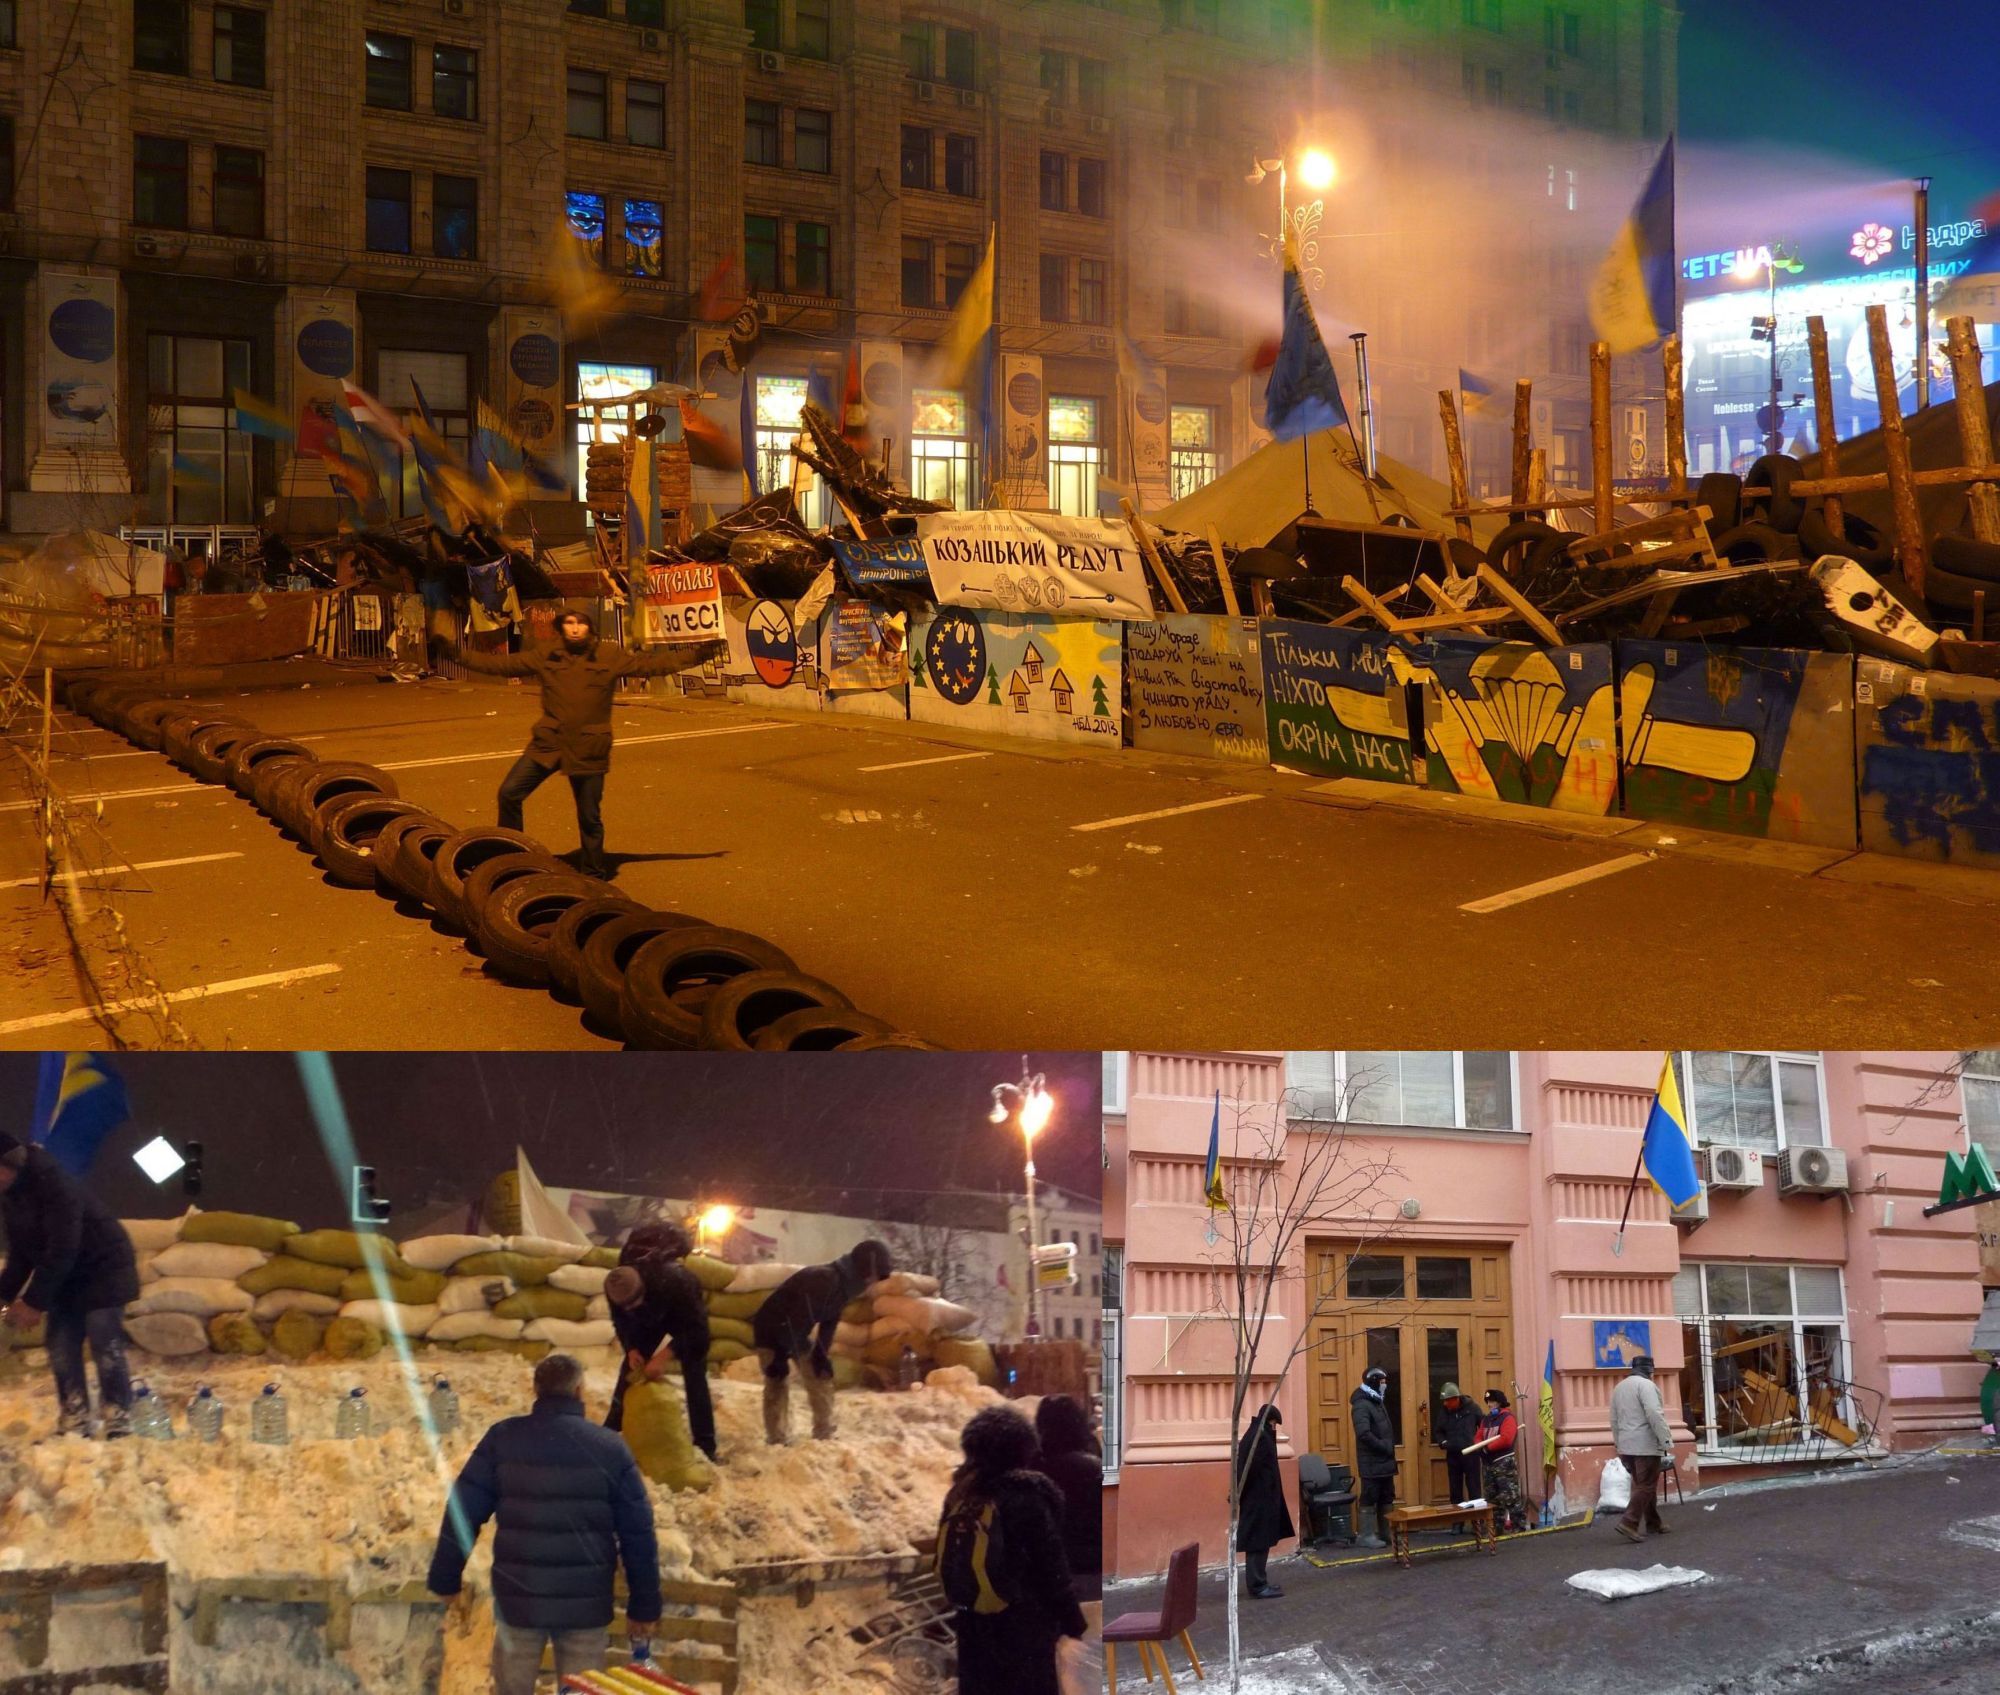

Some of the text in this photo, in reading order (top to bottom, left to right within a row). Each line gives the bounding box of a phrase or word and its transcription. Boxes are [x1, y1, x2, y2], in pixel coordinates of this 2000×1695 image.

[1902, 219, 1988, 249] Надра
[1713, 402, 1755, 415] Noblesse
[932, 537, 1123, 572] КОЗАЦЬКИЙ РЕДУТ
[684, 603, 719, 631] ЄС!
[1160, 624, 1200, 653] Морозе
[1278, 717, 1412, 785] ОКРІМ НАС!
